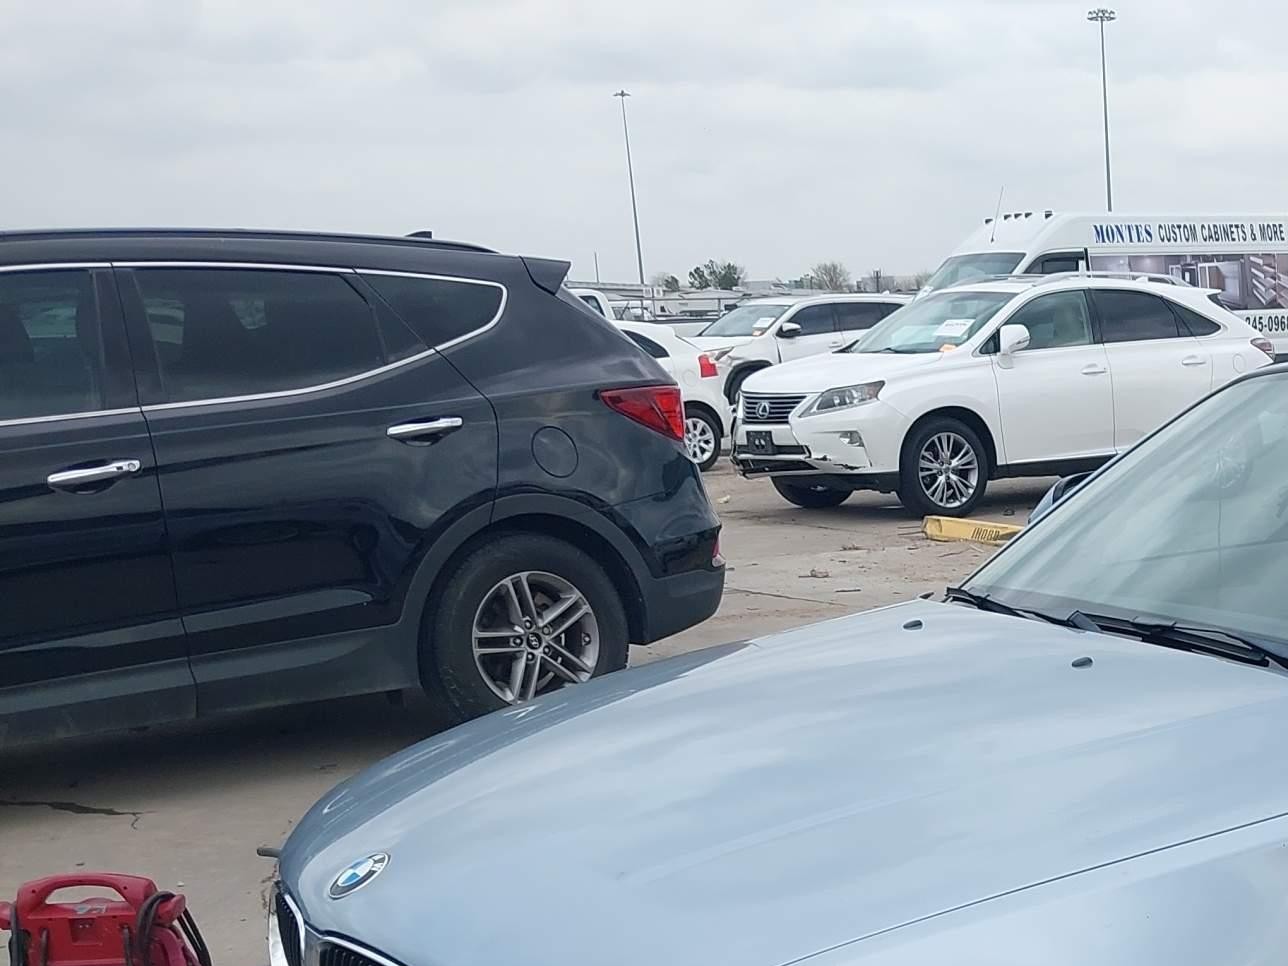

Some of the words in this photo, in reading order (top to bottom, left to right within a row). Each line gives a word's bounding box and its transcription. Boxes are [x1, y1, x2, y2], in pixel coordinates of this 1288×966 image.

[1093, 224, 1153, 244] MONTES
[1158, 223, 1198, 243] CUSTOM
[1200, 223, 1247, 242] CABINETS
[1249, 224, 1257, 241] &
[1259, 223, 1285, 242] MORE
